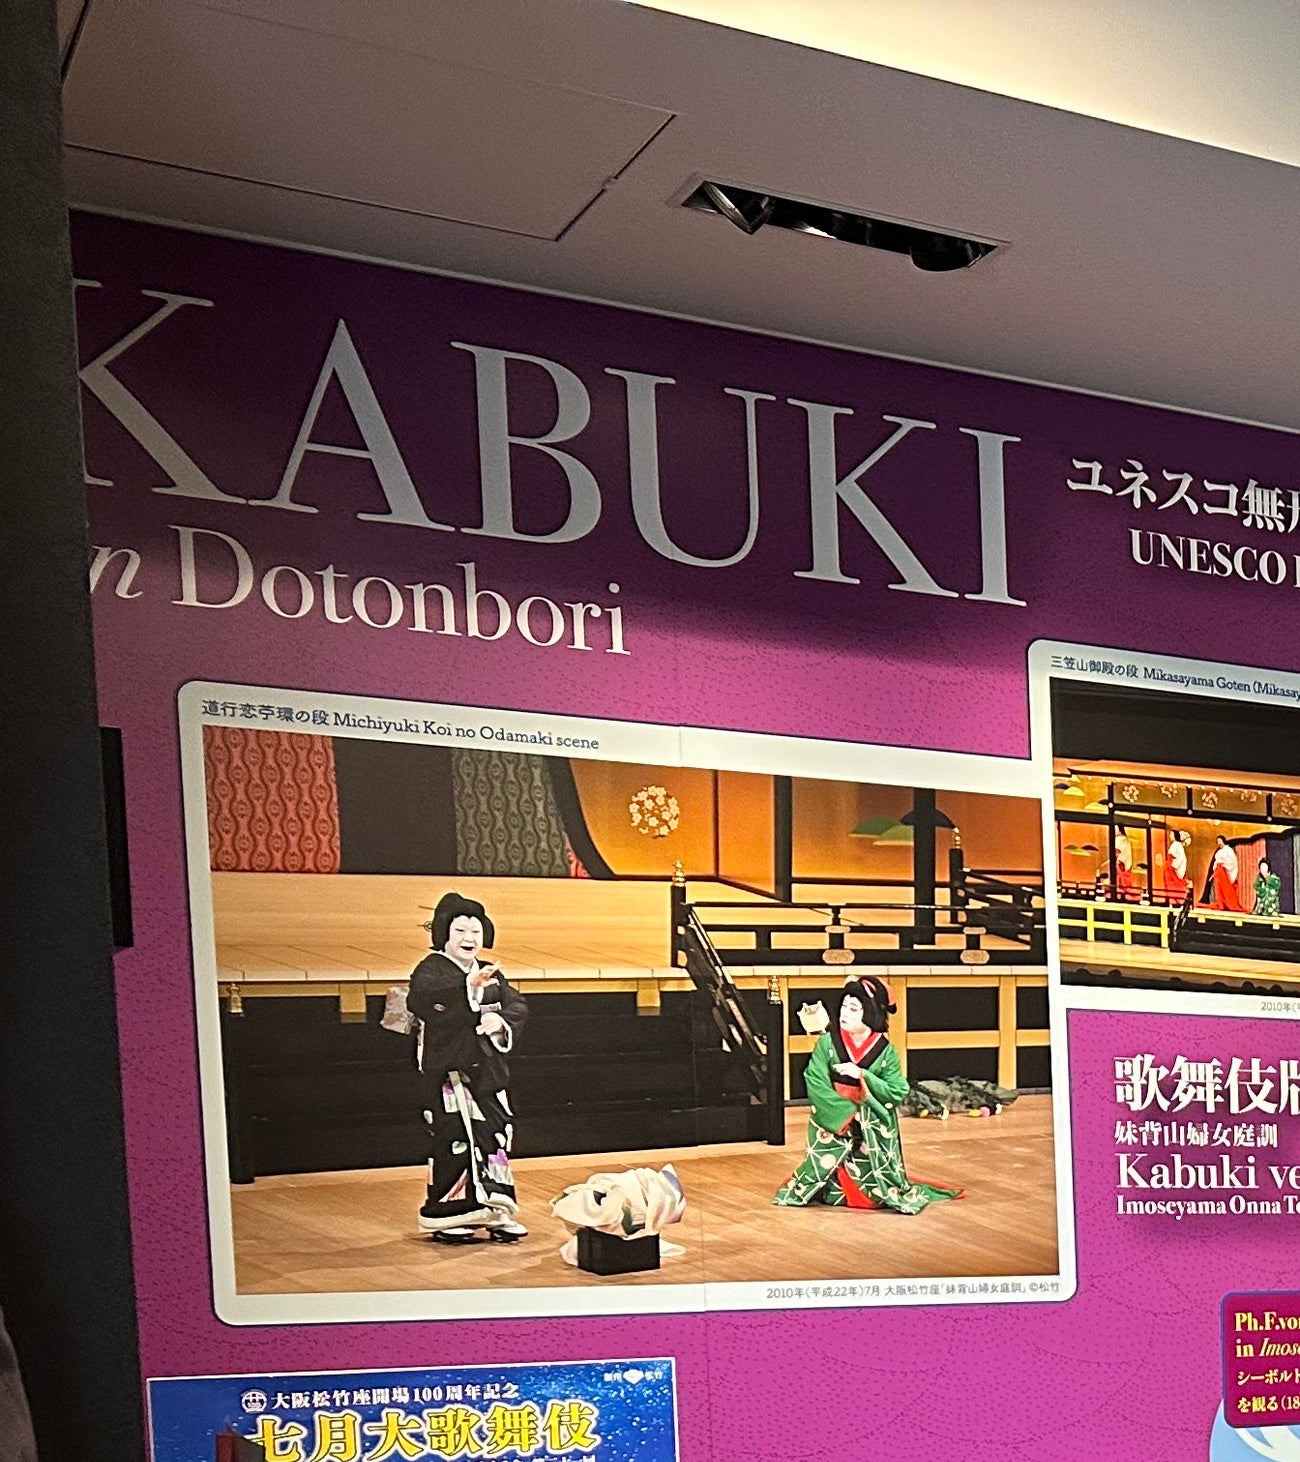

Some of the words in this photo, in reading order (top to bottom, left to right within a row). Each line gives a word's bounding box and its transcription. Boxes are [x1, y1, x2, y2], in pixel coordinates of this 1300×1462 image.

[73, 278, 1028, 607] KABUKI
[1130, 528, 1288, 585] UNESCO
[89, 544, 143, 599] n
[168, 524, 632, 656] Dotonbori
[1050, 656, 1139, 679] 三笠山御殿の段
[1143, 667, 1215, 688] Mikasayama
[1216, 677, 1251, 693] Goten
[333, 711, 420, 735] Michiyuki
[423, 720, 452, 737] Koi
[455, 727, 476, 740] no
[480, 725, 553, 746] Odamaki
[556, 735, 600, 751] scene
[1114, 1120, 1279, 1148] 妹背山婦女庭訓
[1114, 1152, 1260, 1190] Kabuki
[1116, 1194, 1227, 1221] Imoseyama
[1229, 1195, 1282, 1215] Onna
[1236, 1339, 1254, 1358] in
[271, 1382, 520, 1410] 大阪松竹座開場100周年記念
